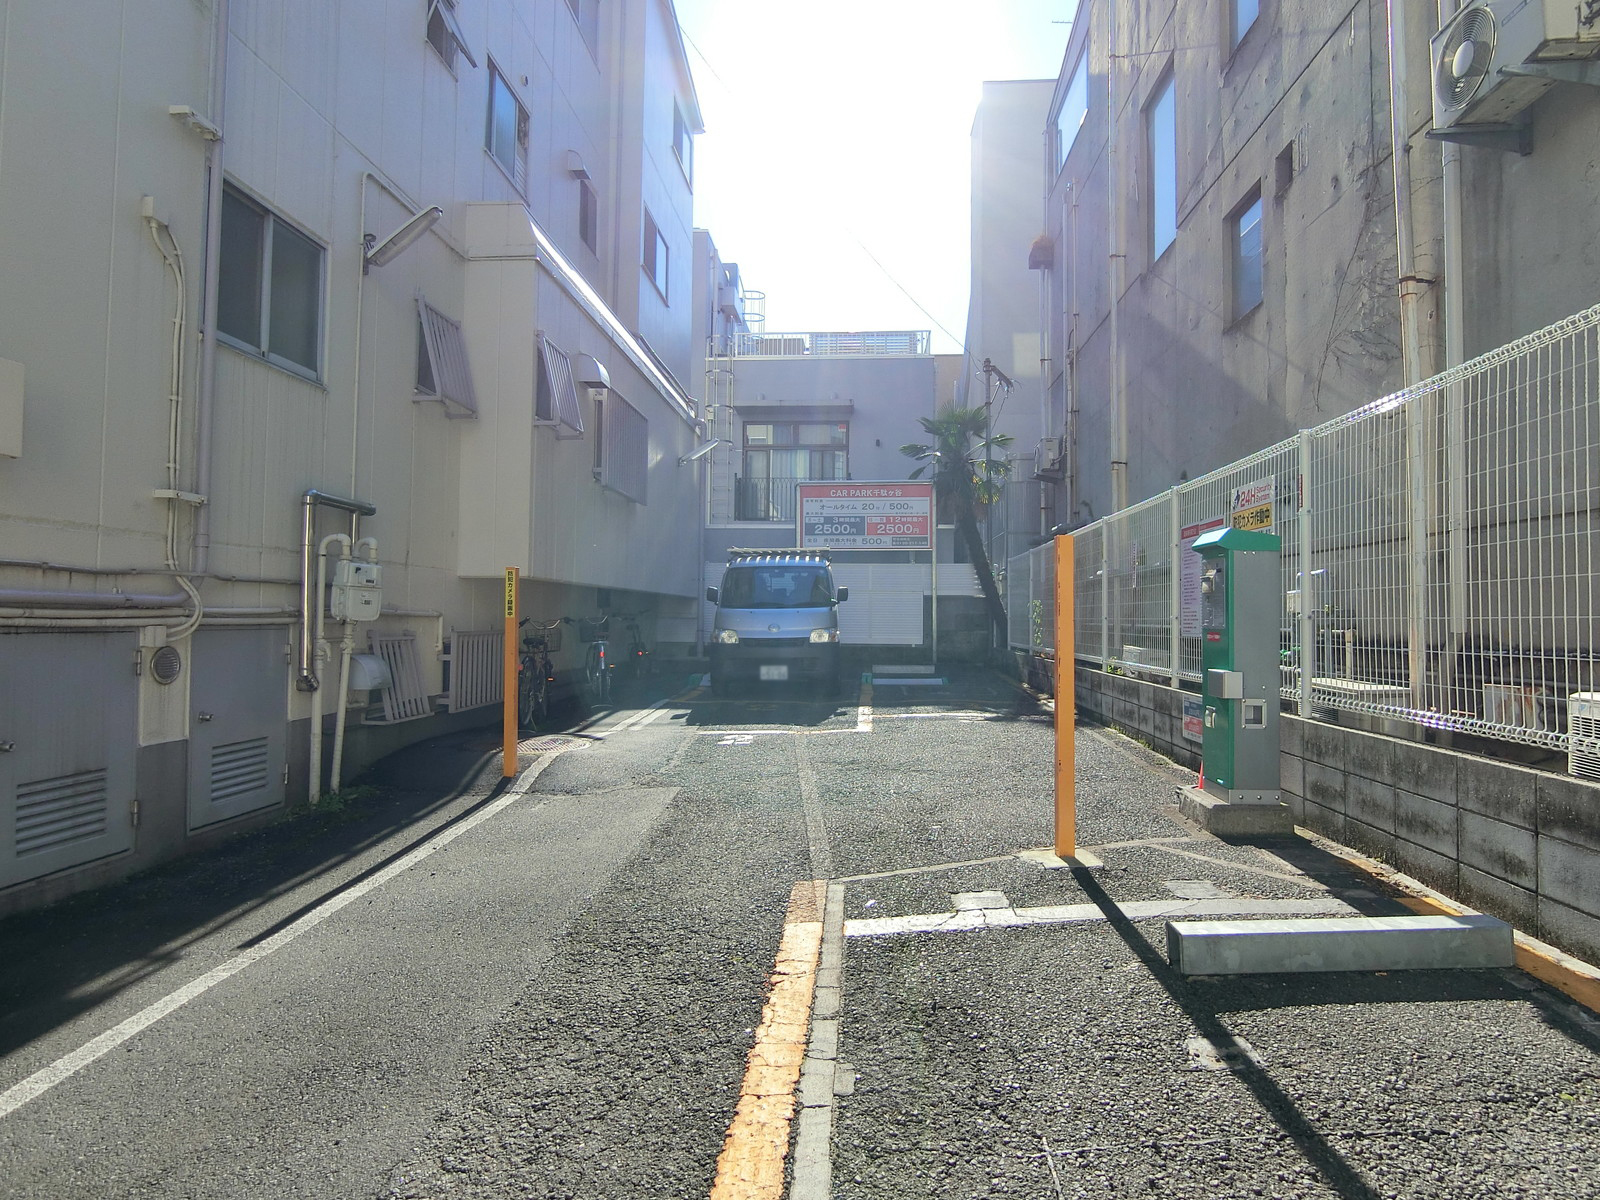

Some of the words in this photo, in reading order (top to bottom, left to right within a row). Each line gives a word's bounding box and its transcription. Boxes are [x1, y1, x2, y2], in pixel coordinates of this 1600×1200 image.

[830, 489, 848, 497] CAR
[1240, 487, 1256, 507] 24H
[814, 524, 857, 534] 2500円
[877, 524, 920, 534] 2500円
